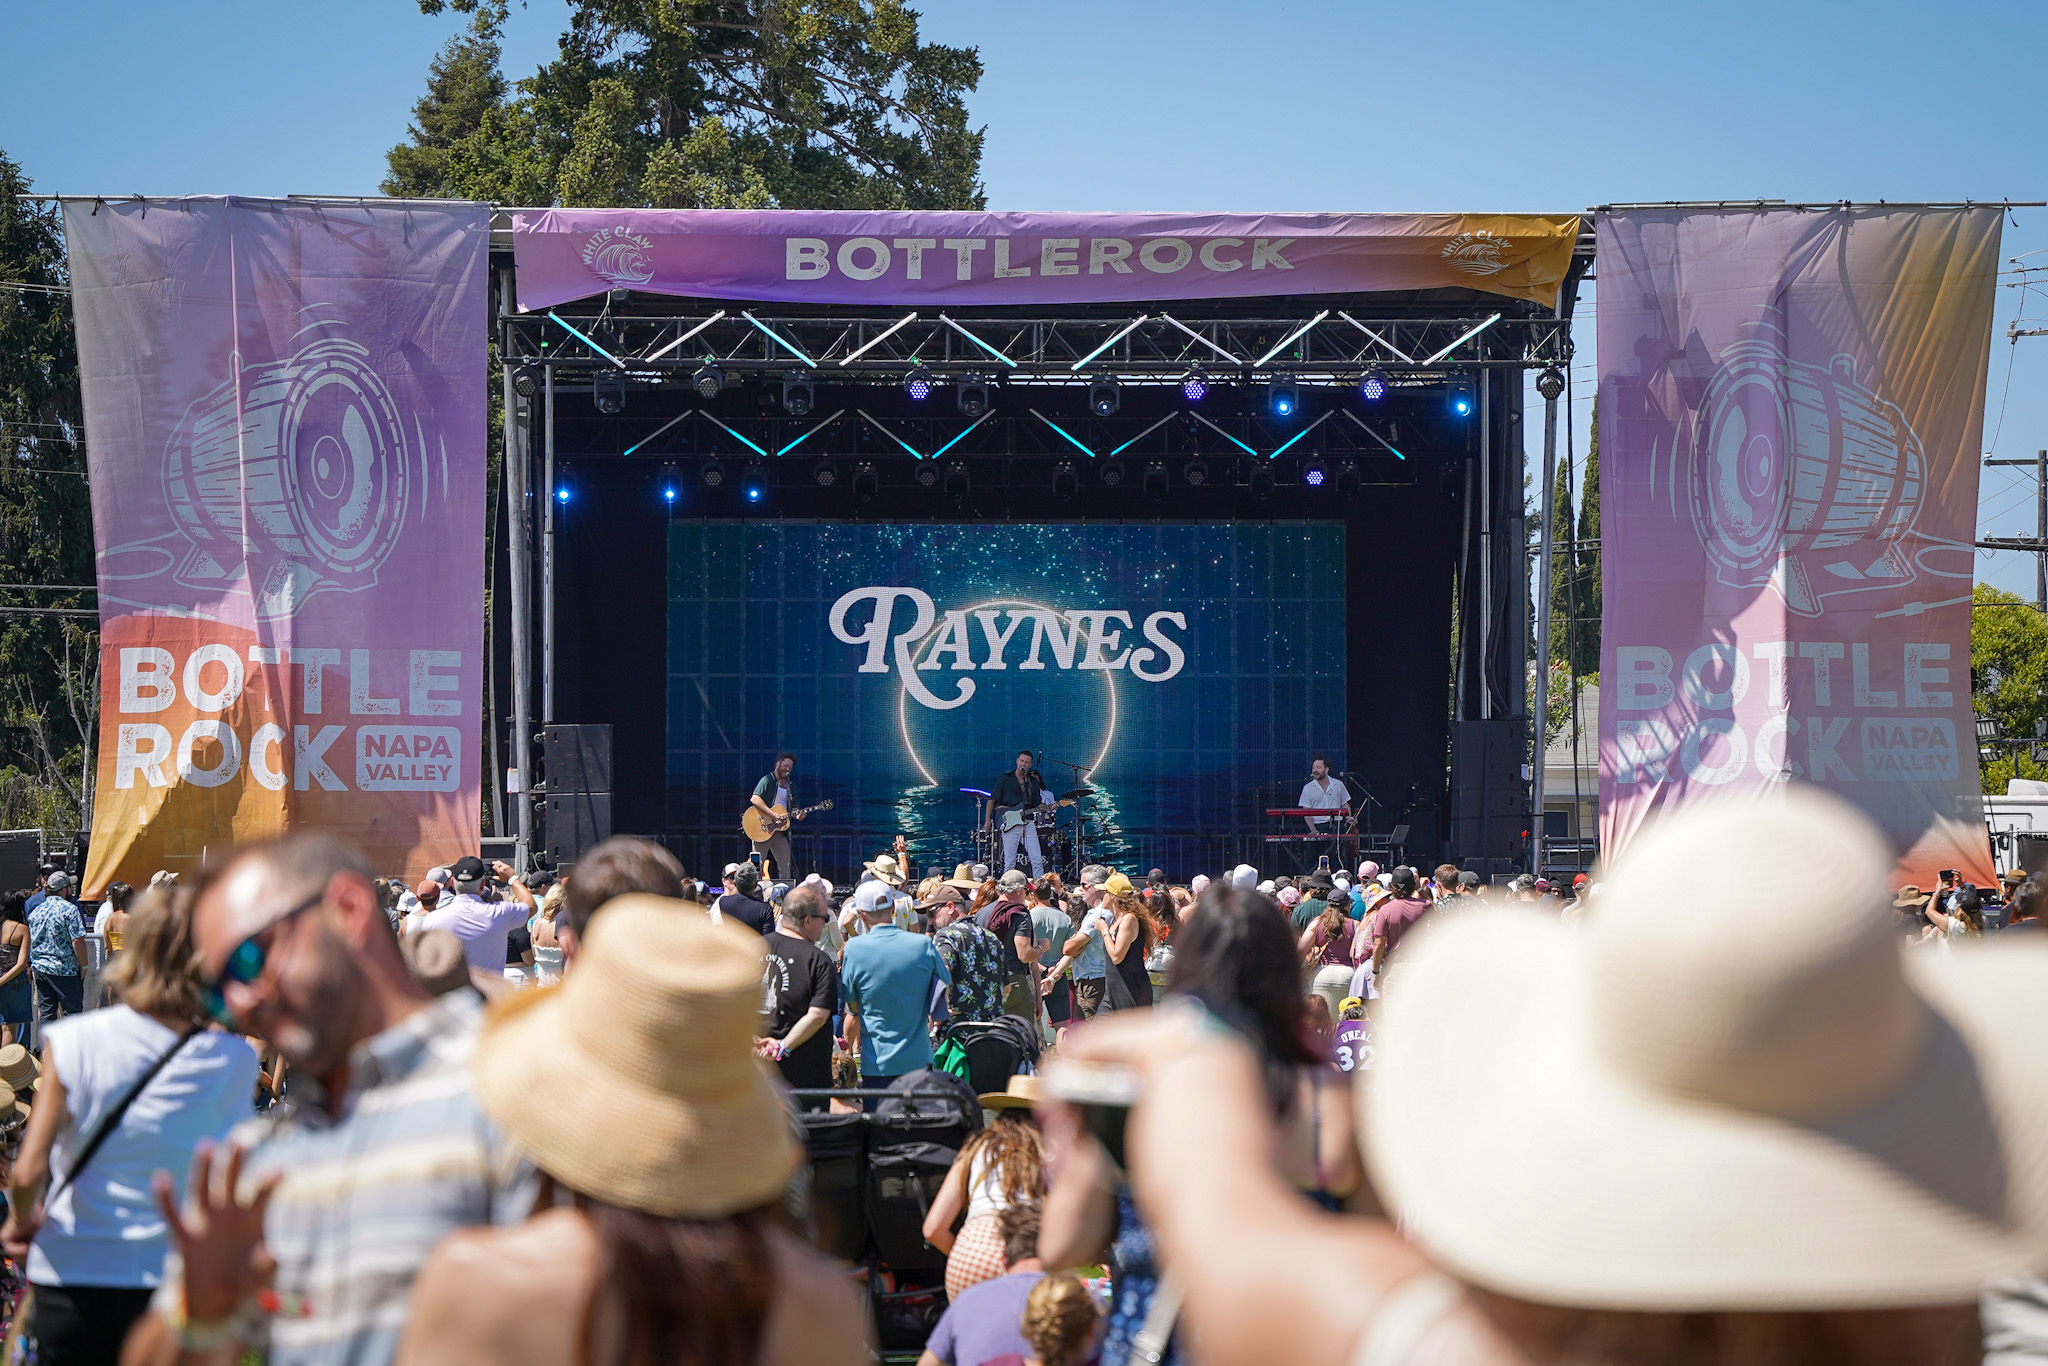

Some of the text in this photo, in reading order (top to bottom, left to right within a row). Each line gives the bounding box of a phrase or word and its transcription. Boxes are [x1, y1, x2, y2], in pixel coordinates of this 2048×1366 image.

[582, 226, 654, 265] WHITE CLAW
[1476, 230, 1513, 248] CLAW
[785, 238, 1296, 281] BOTTLEROCK
[829, 586, 1188, 710] RAYNES
[119, 644, 462, 716] BOTTLE
[1616, 641, 1954, 711] BOTTLE
[365, 735, 454, 759] NAPA
[1616, 715, 1859, 785] ROCK
[1868, 726, 1950, 749] NAPA
[114, 720, 349, 792] ROCK
[1869, 754, 1951, 771] VALLEY
[365, 763, 453, 781] VALLEY
[776, 956, 787, 973] THE
[780, 972, 790, 992] HILL
[1341, 1030, 1371, 1043] O'NEAL
[1336, 1045, 1377, 1072] 32
